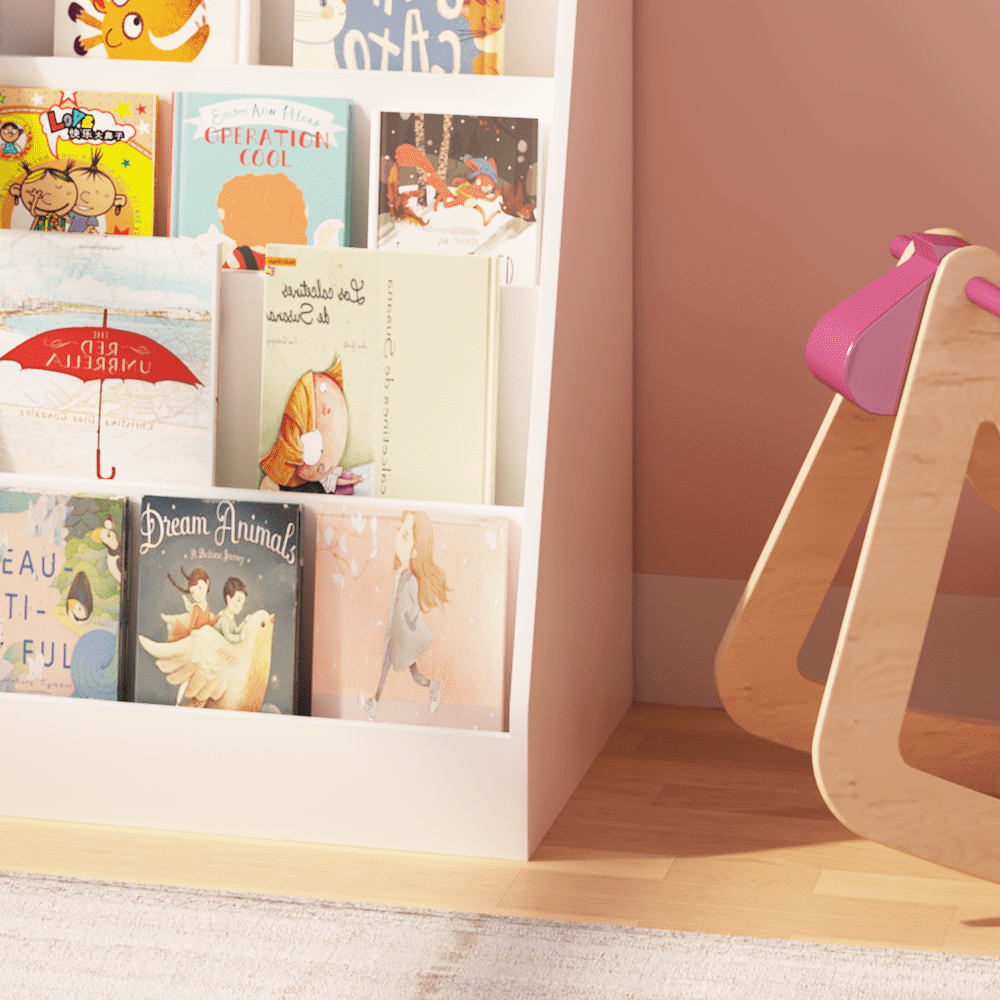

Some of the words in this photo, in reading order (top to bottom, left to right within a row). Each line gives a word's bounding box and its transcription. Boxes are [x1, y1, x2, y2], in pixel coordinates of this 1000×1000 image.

[204, 126, 329, 149] OPERATION
[239, 148, 293, 168] COOL
[140, 502, 211, 555] Dream
[214, 500, 297, 564] Animals
[5, 593, 46, 620] TI-
[22, 639, 72, 669] FUL
